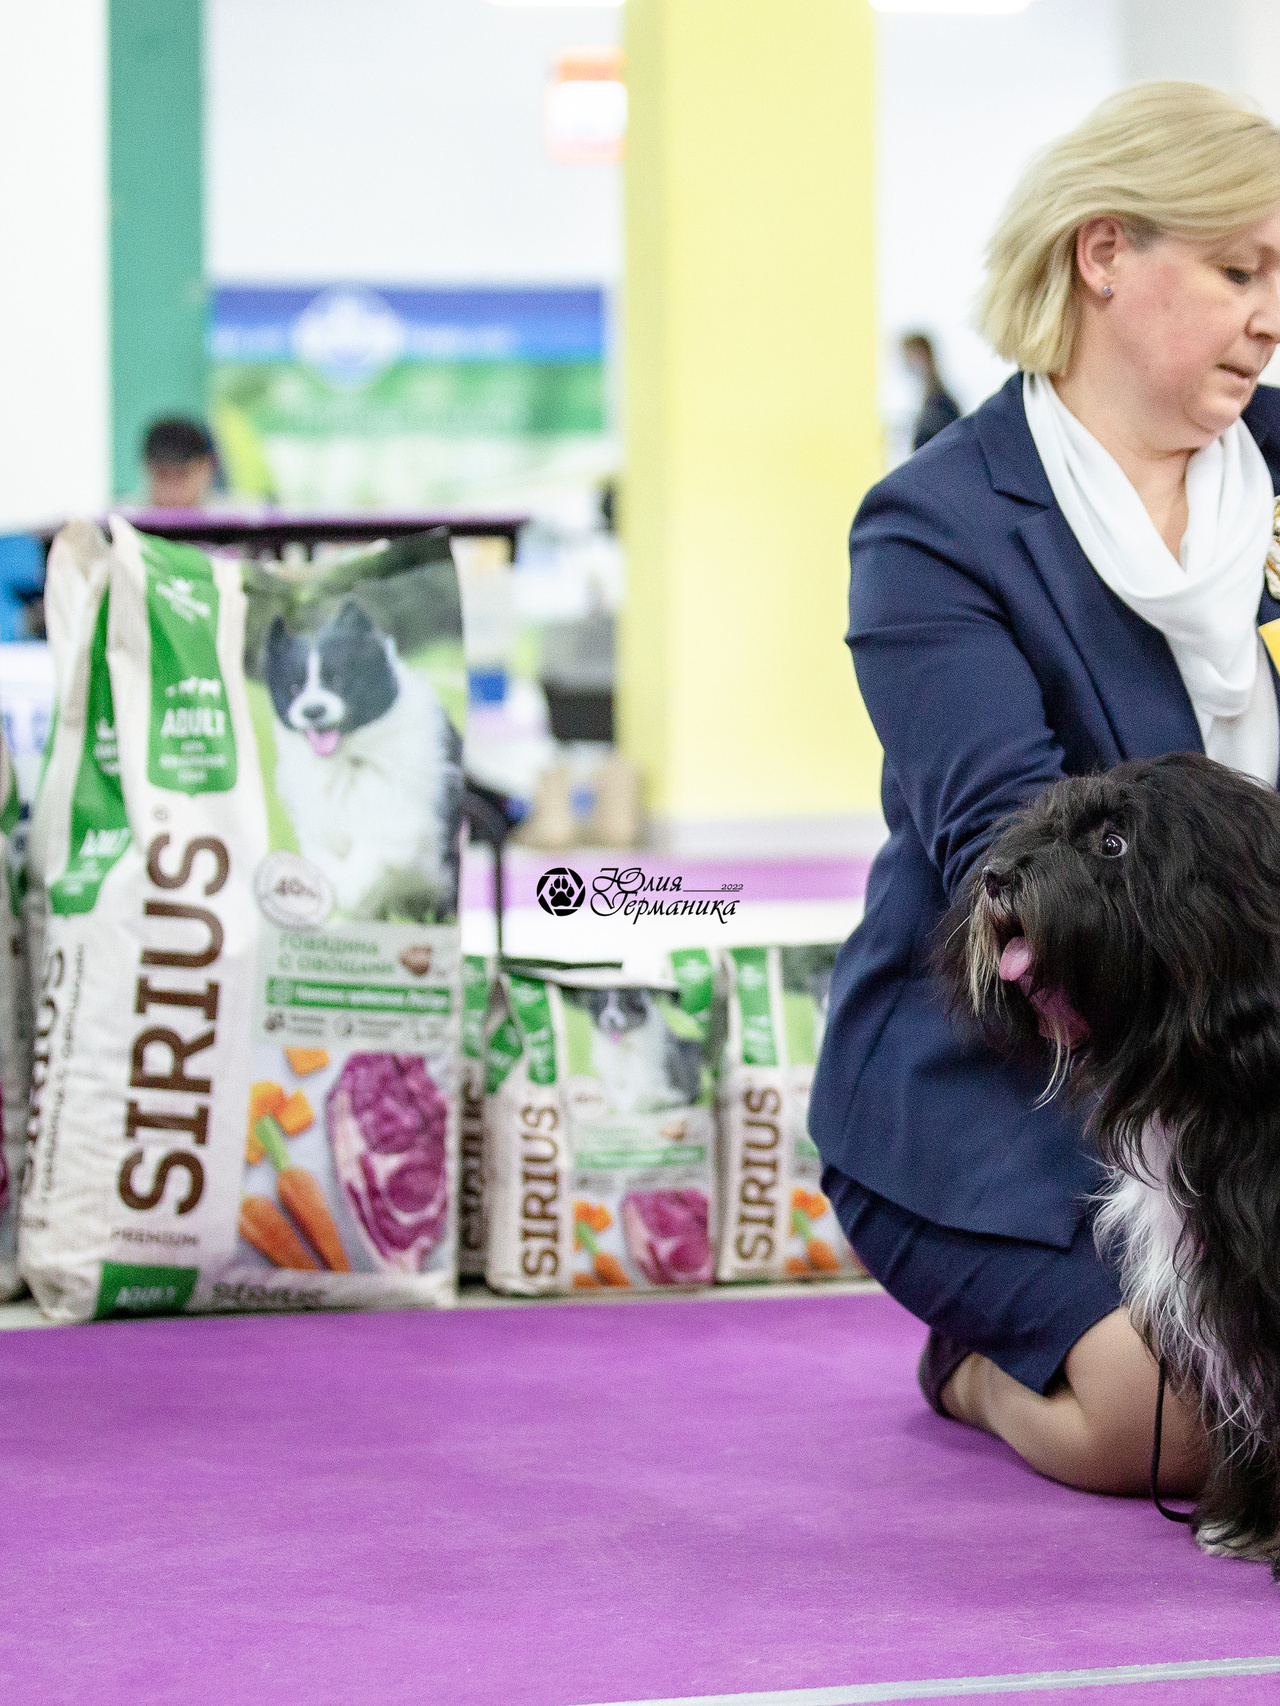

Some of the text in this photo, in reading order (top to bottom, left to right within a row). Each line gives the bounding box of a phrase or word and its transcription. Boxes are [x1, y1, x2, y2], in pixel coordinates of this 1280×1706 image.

[160, 707, 226, 738] ADULT
[116, 832, 230, 1216] SIRIUS
[521, 1104, 560, 1278] SIRIUS
[735, 1086, 782, 1261] SIRIUS
